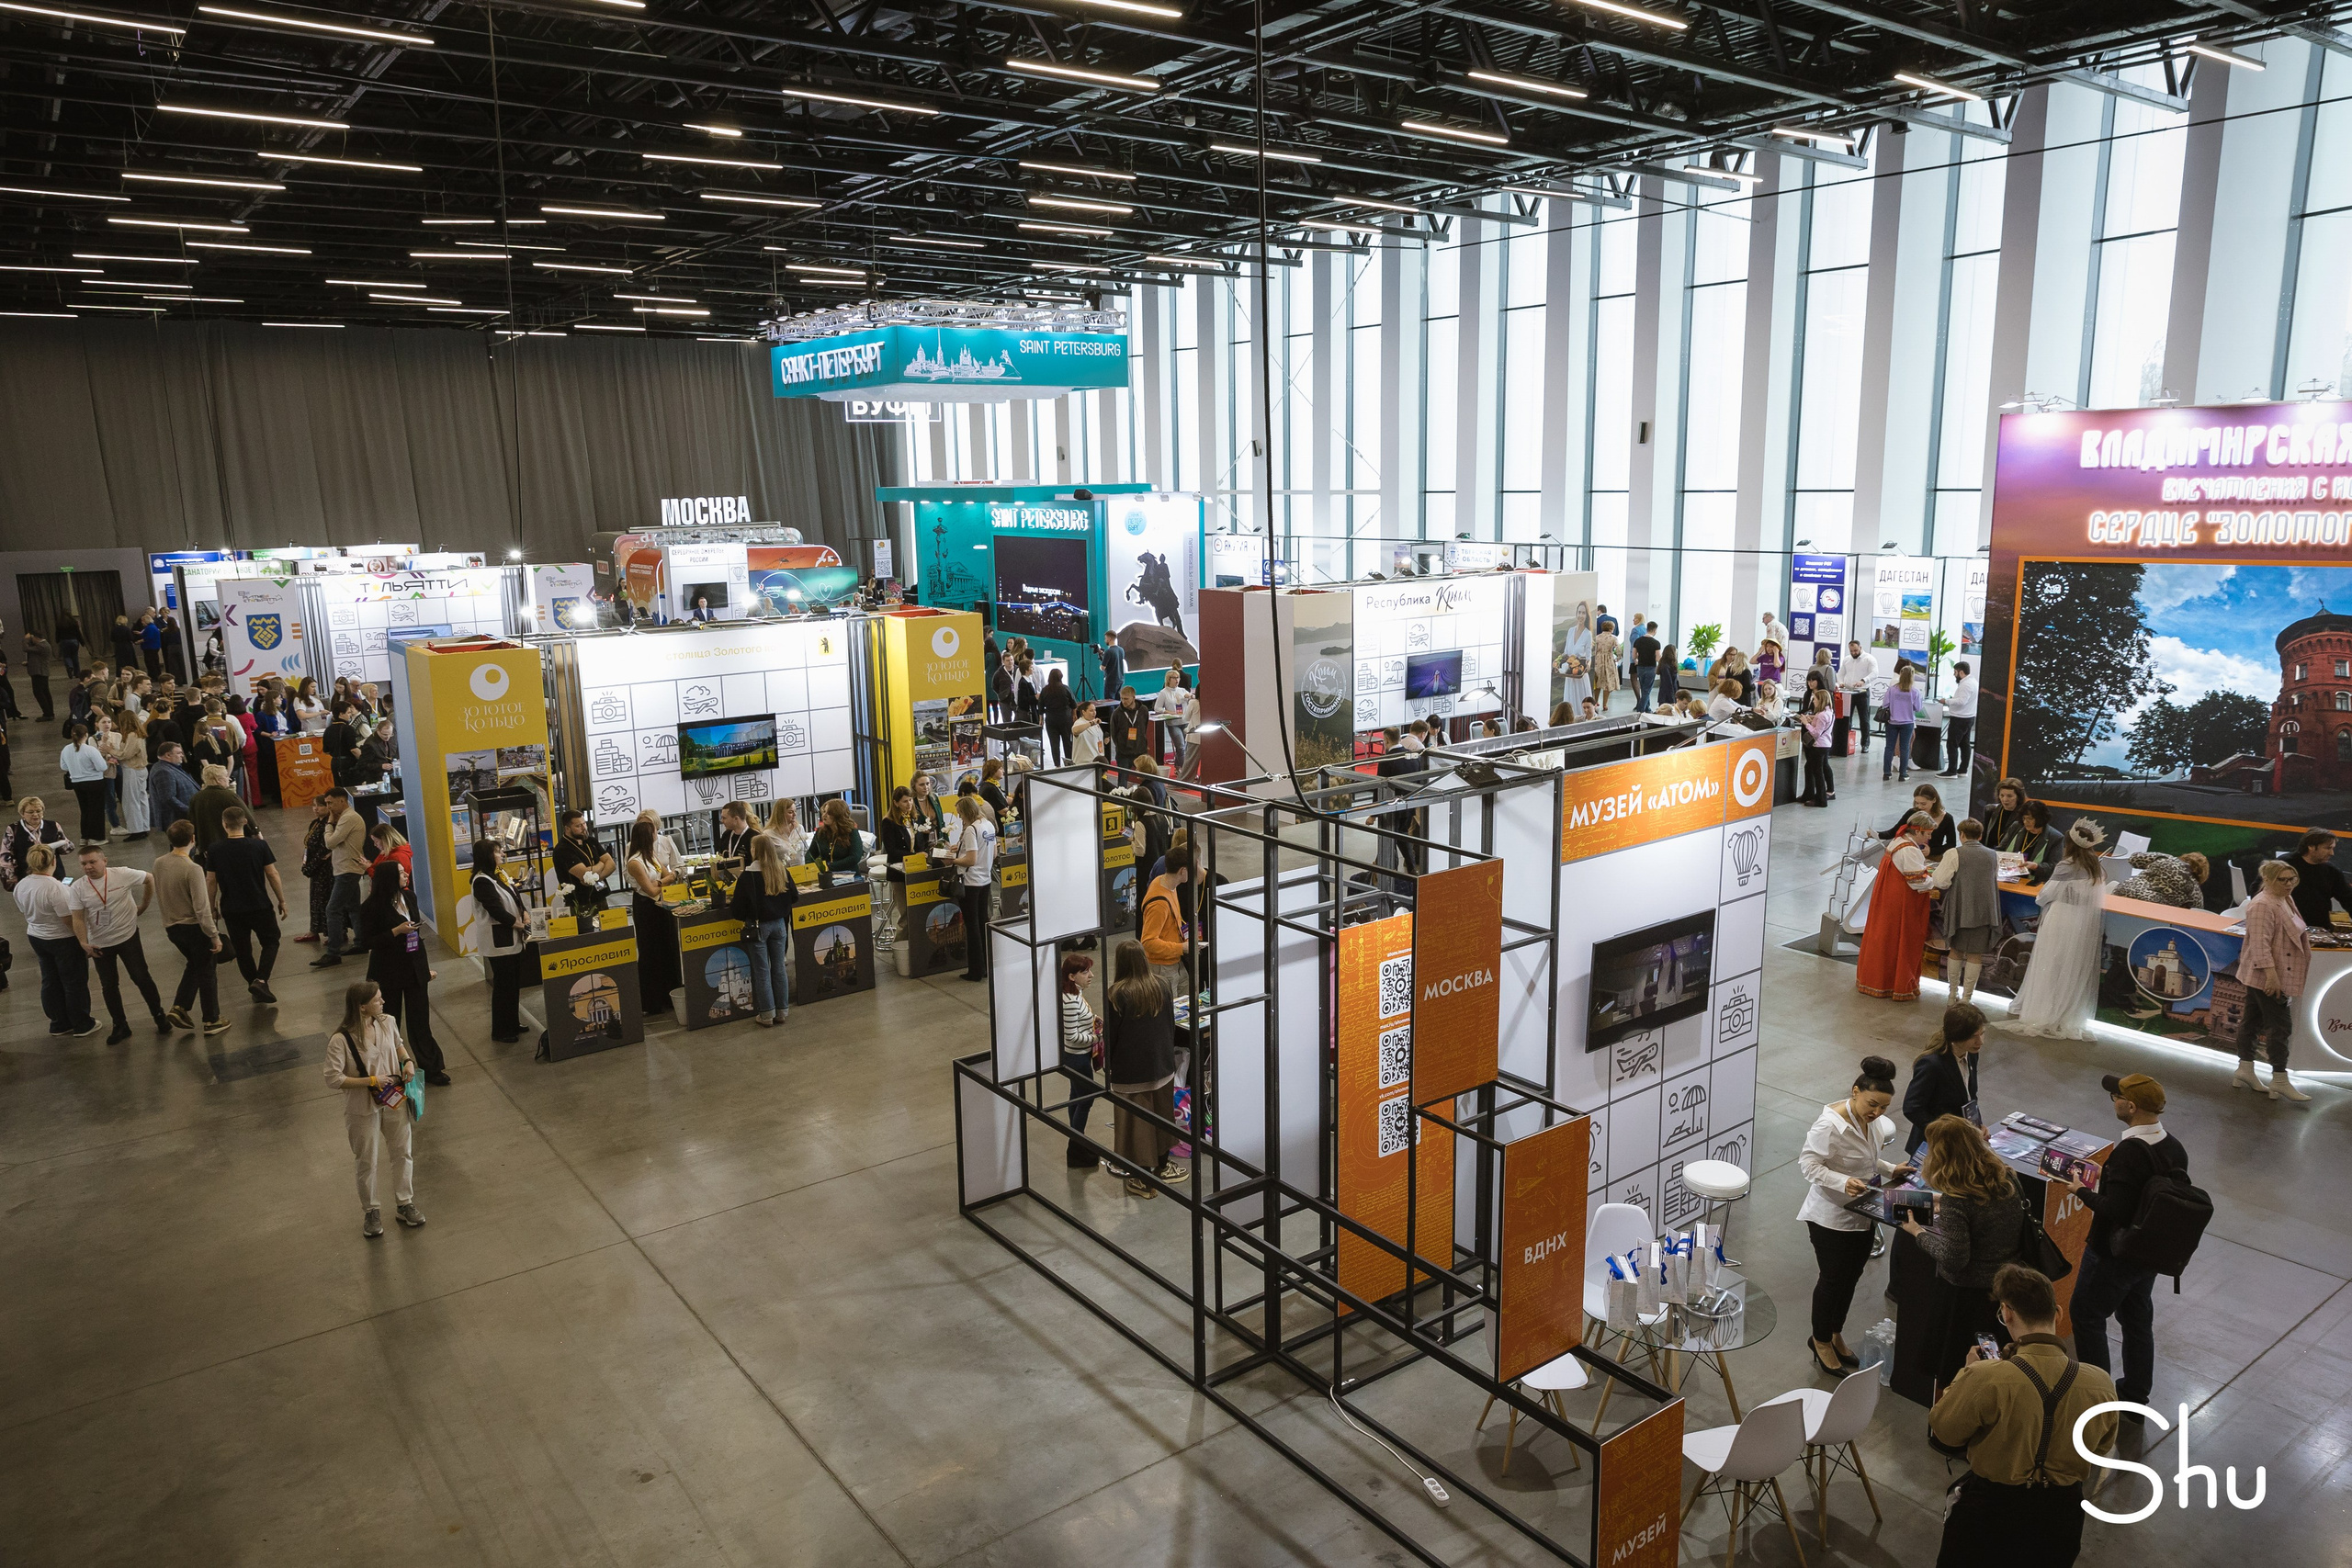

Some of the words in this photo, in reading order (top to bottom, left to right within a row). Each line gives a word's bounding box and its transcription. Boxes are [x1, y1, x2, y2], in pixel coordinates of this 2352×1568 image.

[1020, 339, 1050, 355] SAINT
[1054, 341, 1121, 356] PETERSBURG
[781, 341, 886, 385] САНКТ-ПЕТЕРБУРГ
[853, 400, 932, 416] БУФ
[2080, 423, 2352, 471] ВЛАДИМИРСКАЯ
[2162, 477, 2308, 501] ВПЕЧАТЛЕНИЯ
[2312, 476, 2328, 500] С
[662, 496, 751, 526] МОСКВА
[991, 507, 1018, 528] SAINT
[1021, 508, 1090, 531] PETERSBURG
[2088, 511, 2199, 547] СЕРДЦЕ
[1879, 570, 1928, 583] ДАГЕСТАН
[1971, 572, 1988, 585] ДА
[1366, 593, 1430, 610] Республика
[666, 649, 711, 661] столица
[714, 646, 762, 657] Золотого
[923, 660, 970, 675] ЗОЛОТОЕ
[927, 669, 970, 685] КОЛЬЦО
[1309, 663, 1337, 687] Крым
[1305, 687, 1344, 715] ГОСТЕПРИИМНЫЙ
[458, 703, 526, 722] ЗОЛОТОЕ
[465, 715, 525, 734] КОЛЬЦО
[1569, 784, 1643, 829] МУЗЕЙ
[1647, 776, 1720, 811] «АТОМ»
[1014, 871, 1027, 880] Яр
[910, 888, 940, 899] Золото
[808, 903, 865, 921] Ярославия
[684, 930, 728, 943] Золотое
[560, 948, 630, 970] Ярославия
[1423, 967, 1494, 1001] МОСКВА
[2327, 1019, 2352, 1032] Впе
[2054, 1193, 2084, 1225] АТО
[1523, 1231, 1567, 1265] ВДНХ
[1612, 1513, 1667, 1565] МУЗЕЙ
